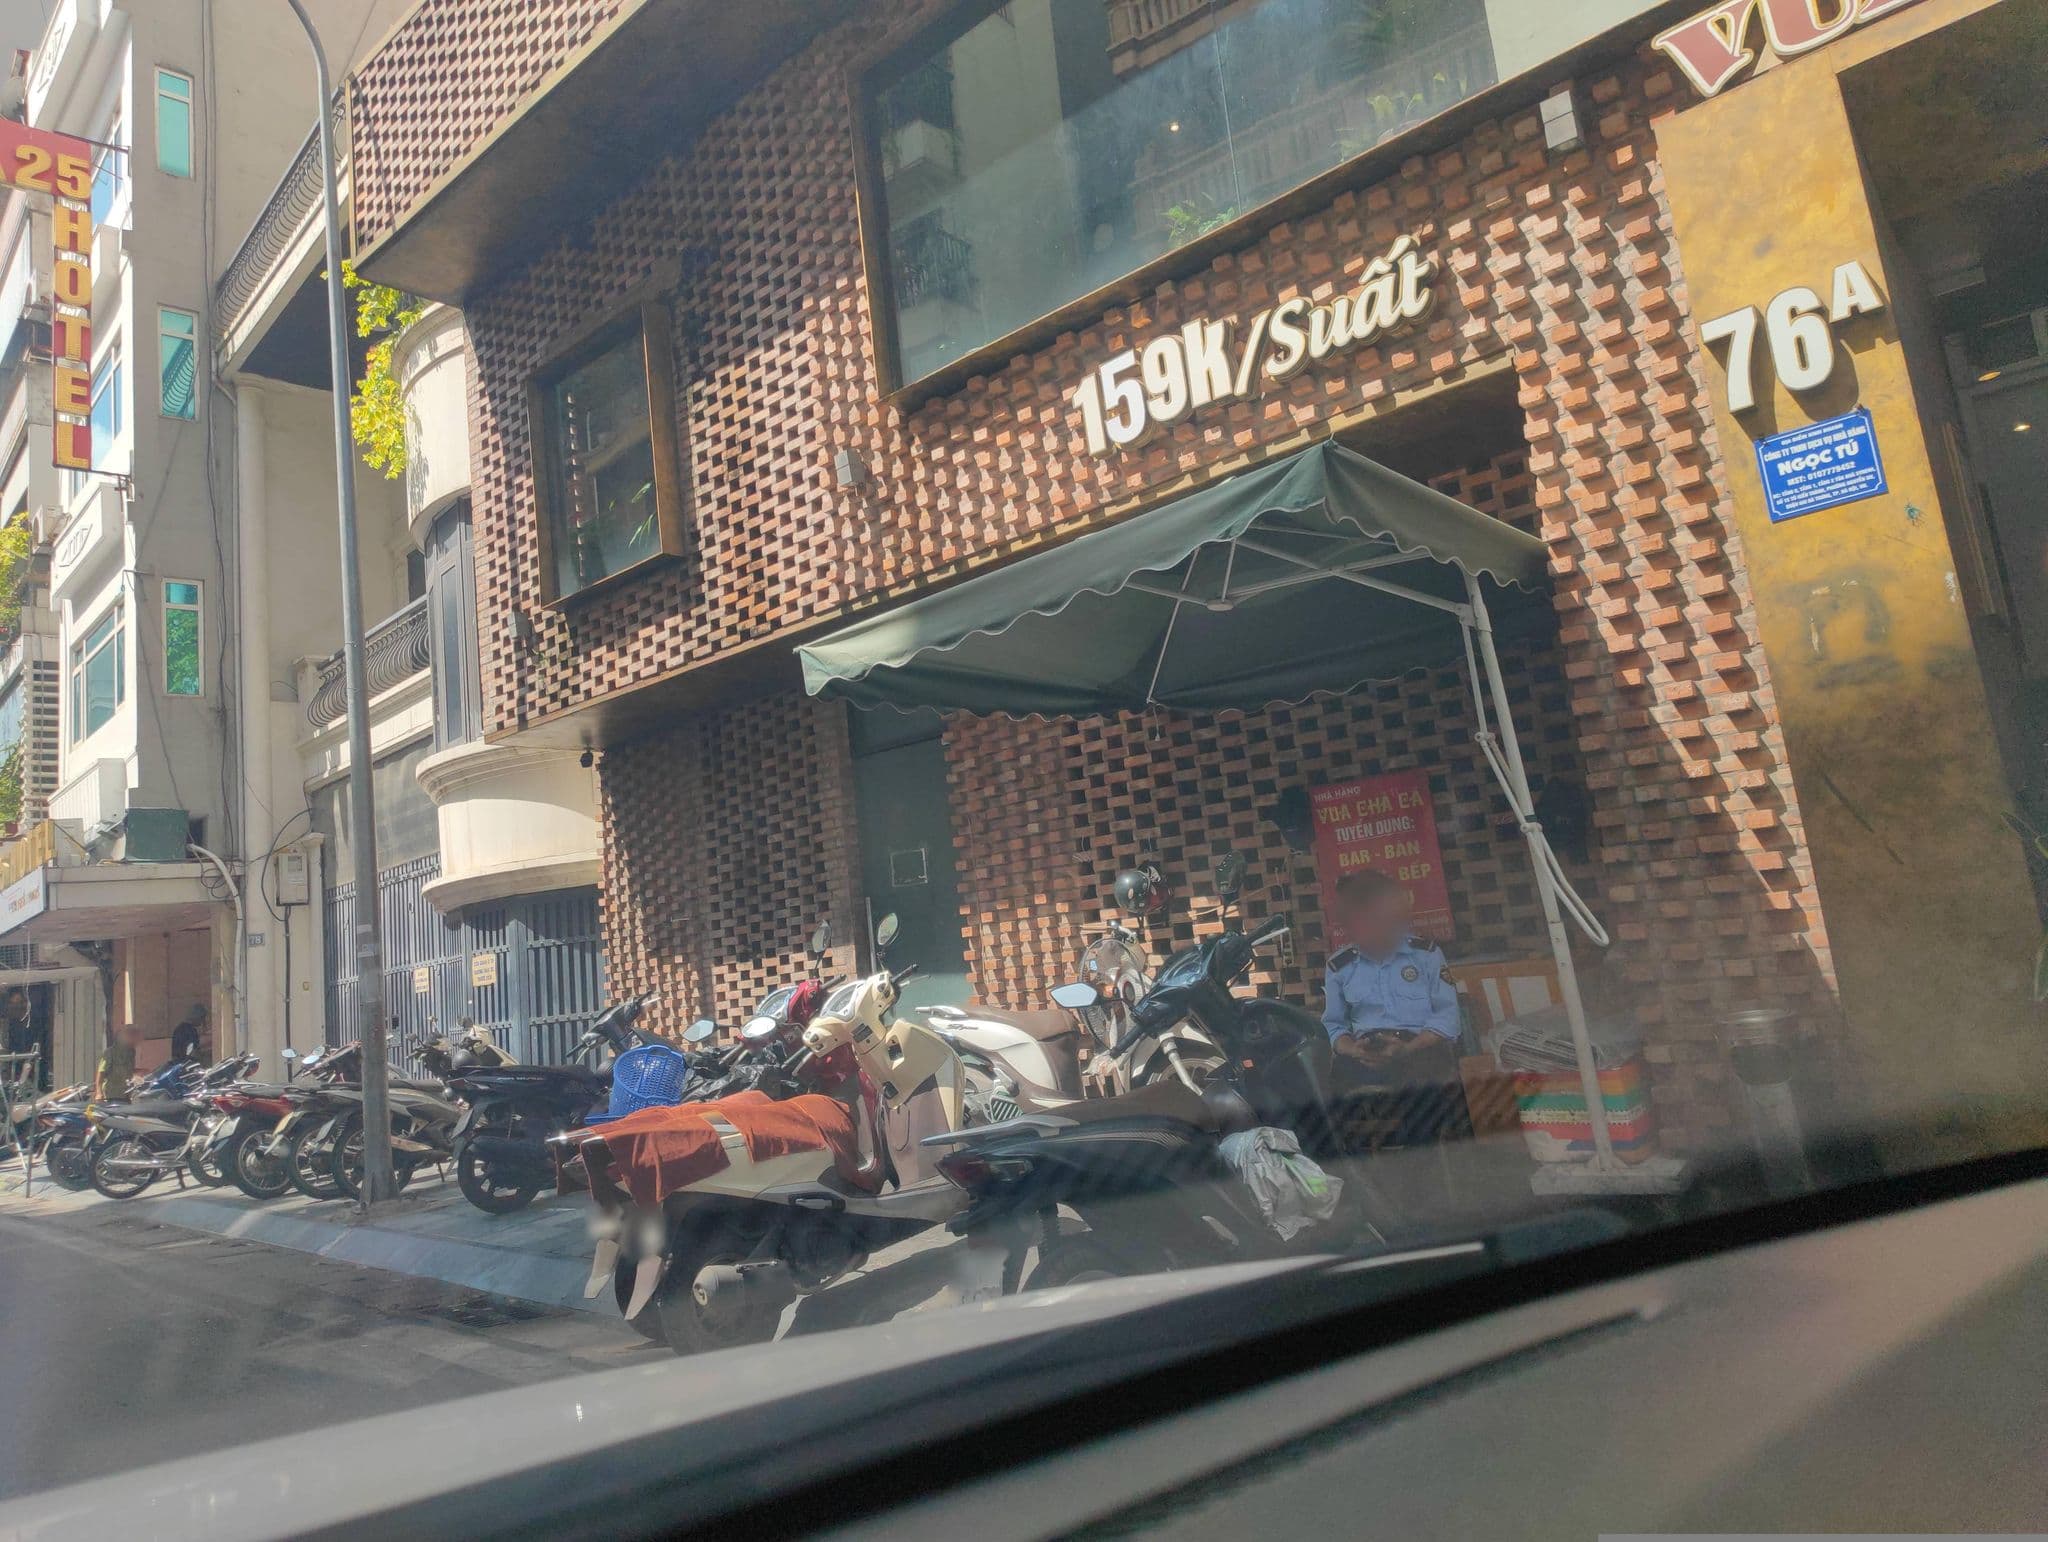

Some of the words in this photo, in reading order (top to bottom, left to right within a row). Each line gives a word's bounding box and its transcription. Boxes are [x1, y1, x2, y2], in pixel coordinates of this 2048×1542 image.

[1651, 0, 1912, 97] VU
[0, 144, 92, 199] 25
[54, 203, 91, 469] HOTEL
[1700, 260, 1884, 412] 76A
[1777, 448, 1833, 476] NGỌC
[1834, 439, 1860, 459] TÚ
[1339, 849, 1370, 868] BAR
